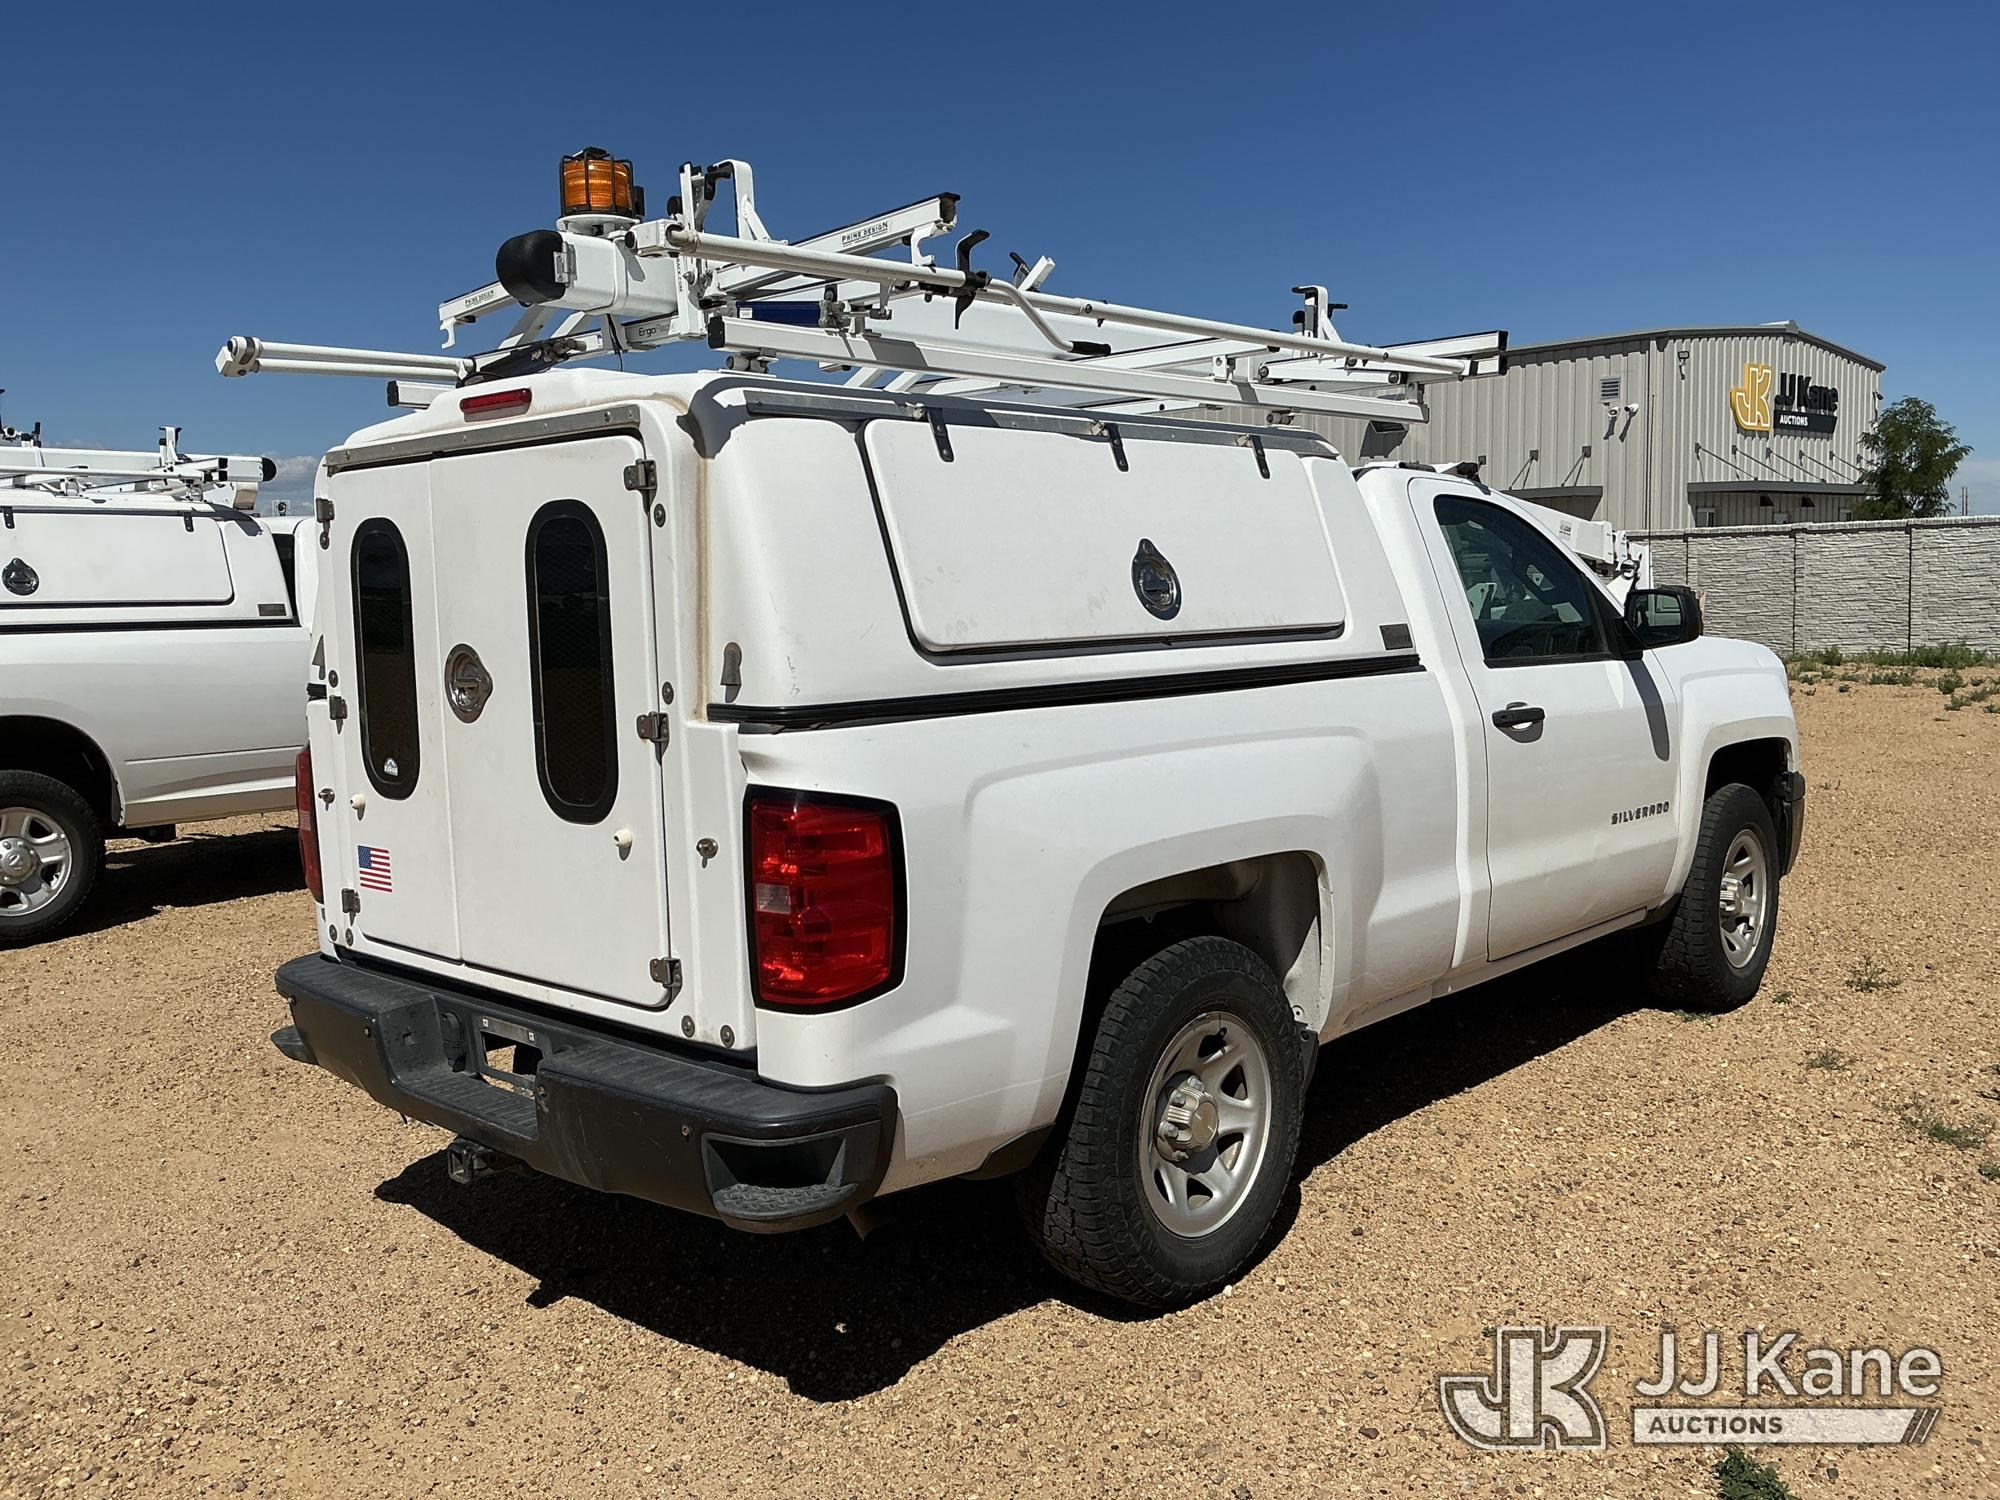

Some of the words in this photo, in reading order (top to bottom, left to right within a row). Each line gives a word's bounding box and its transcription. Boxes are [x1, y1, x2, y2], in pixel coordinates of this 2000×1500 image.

[842, 231, 861, 243] PRIME
[863, 221, 888, 236] DESIGN
[1774, 372, 1795, 406] JJ
[1797, 375, 1839, 412] Kane
[1779, 414, 1809, 427] AUCTIONS
[1611, 801, 1669, 825] SILVERADO
